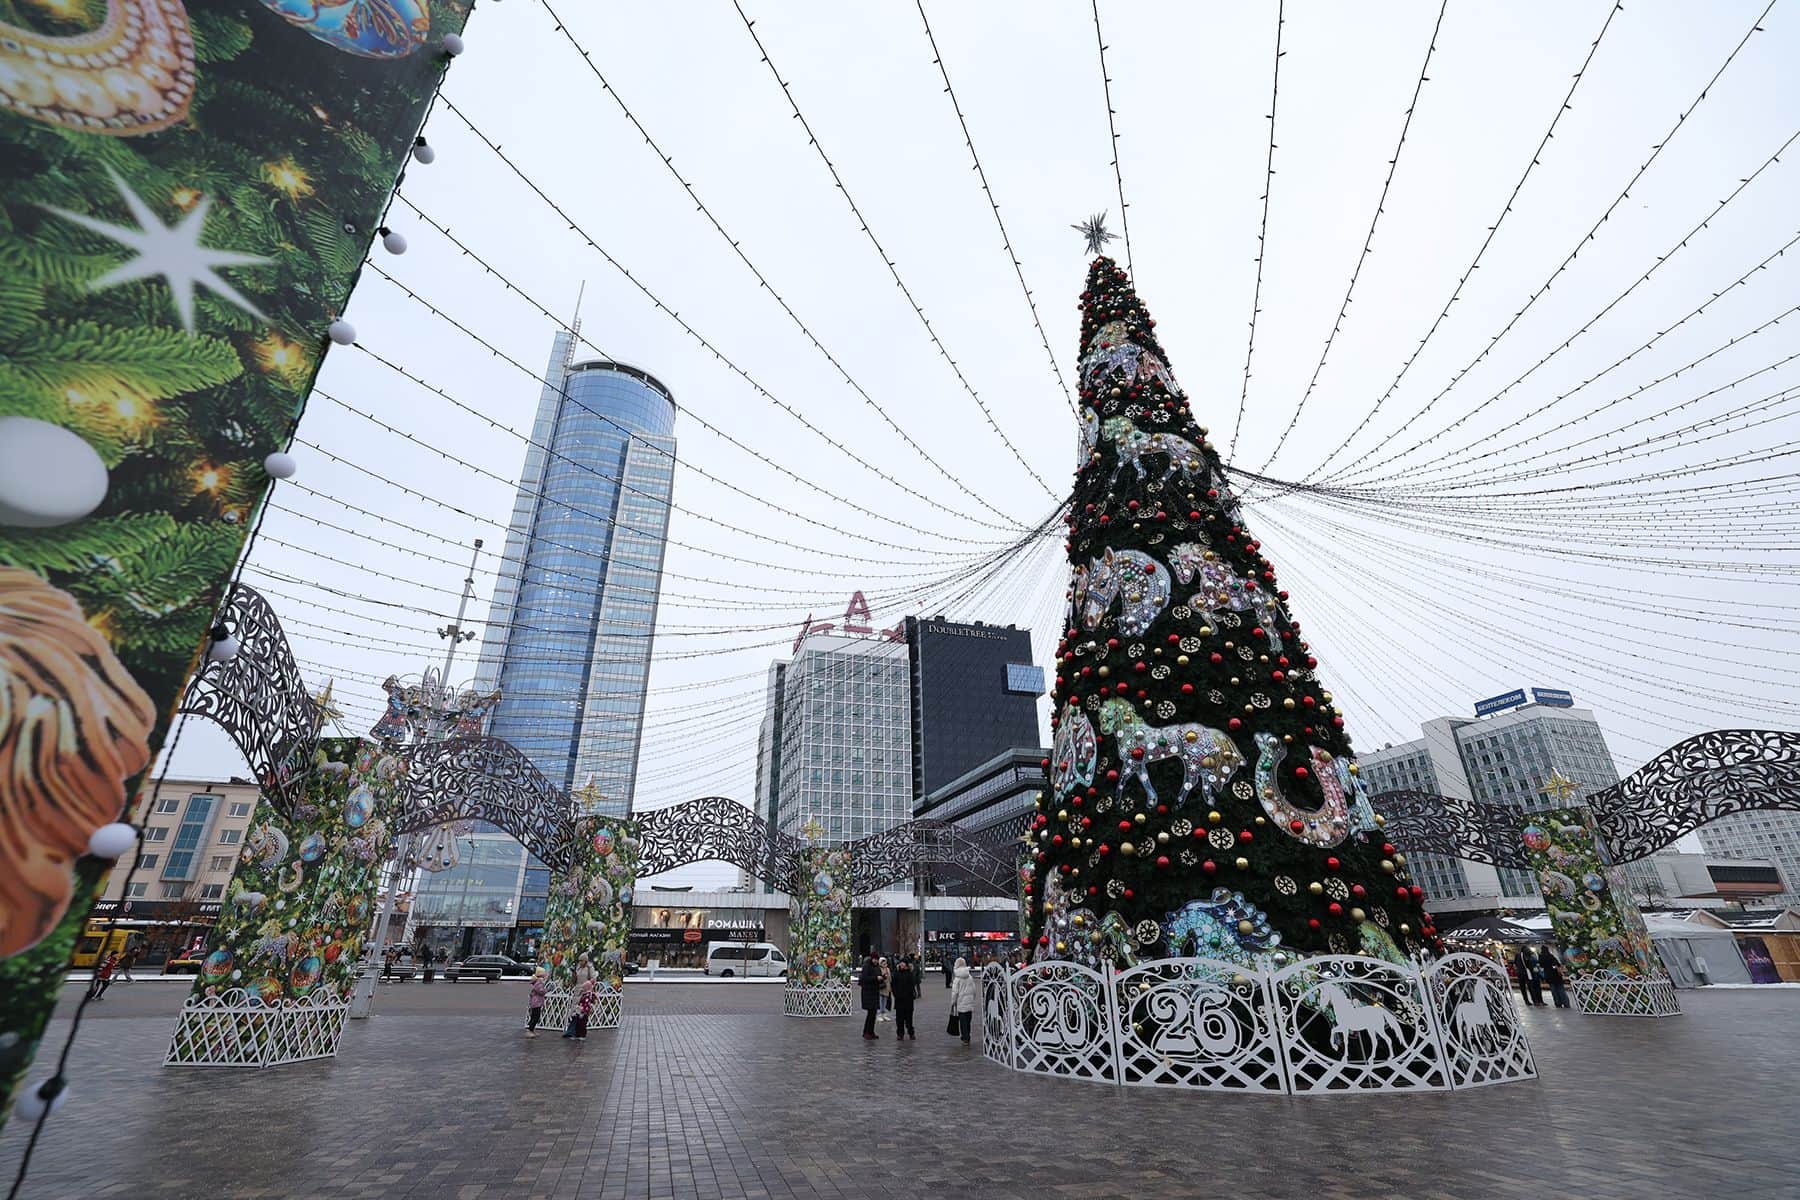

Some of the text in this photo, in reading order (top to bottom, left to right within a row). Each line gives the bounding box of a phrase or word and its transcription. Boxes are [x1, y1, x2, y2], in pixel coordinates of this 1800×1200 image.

[707, 919, 764, 929] РОМАШКА
[939, 932, 956, 940] KFC
[1029, 984, 1242, 1060] 20 26
